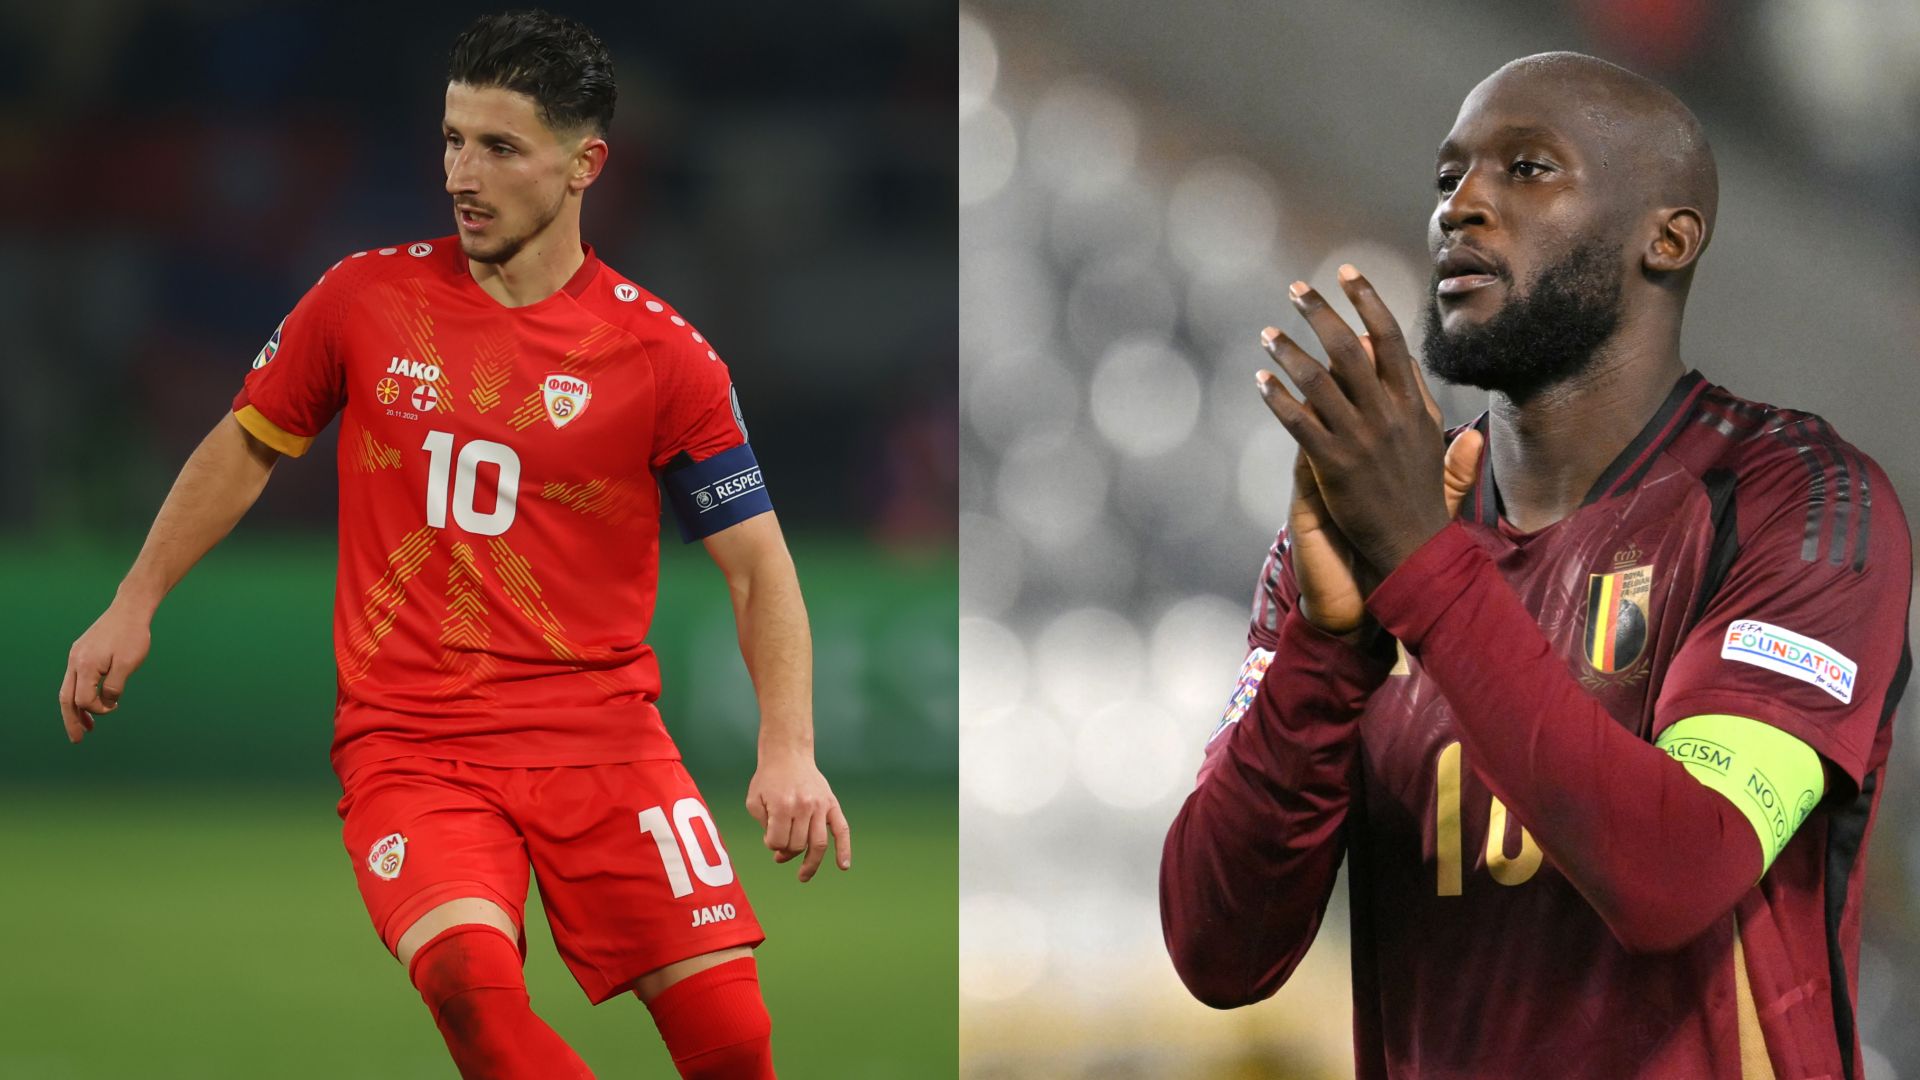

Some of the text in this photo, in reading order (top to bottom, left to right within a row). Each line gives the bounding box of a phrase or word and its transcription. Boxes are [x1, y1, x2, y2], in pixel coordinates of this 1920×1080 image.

[386, 356, 440, 382] JAKO
[386, 408, 418, 420] 20.11.2023
[421, 430, 521, 536] 10
[1667, 742, 1731, 770] ACISM
[1747, 774, 1774, 809] NO
[1773, 806, 1785, 838] TO
[638, 797, 734, 899] 10
[691, 903, 736, 928] JAKO
